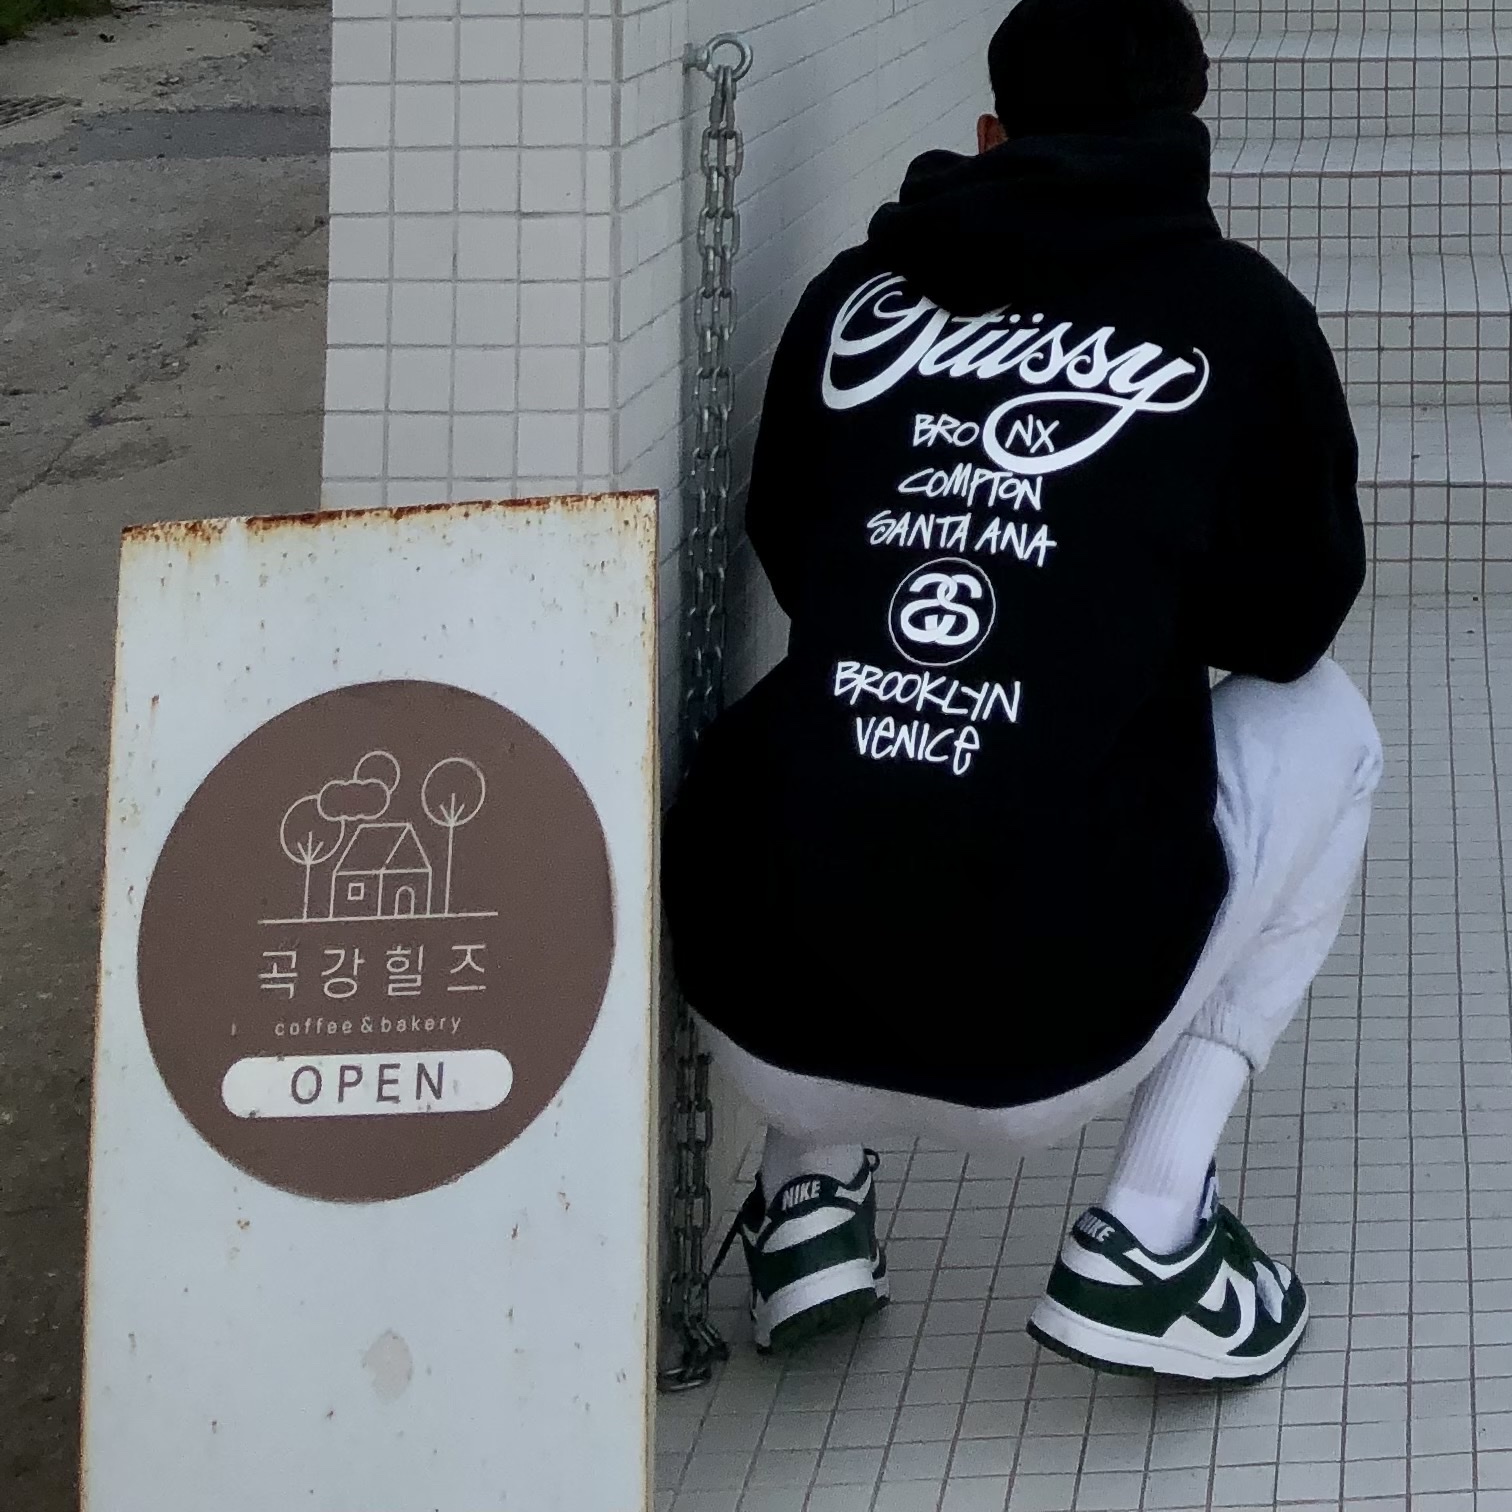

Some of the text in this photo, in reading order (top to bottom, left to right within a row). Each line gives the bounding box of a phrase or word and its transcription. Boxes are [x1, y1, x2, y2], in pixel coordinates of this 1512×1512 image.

[897, 462, 1043, 511] COMPTON
[866, 509, 1058, 568] SANTA ANA
[833, 660, 1021, 724] BROOKLYN
[290, 1061, 445, 1105] OPEN
[781, 1179, 821, 1211] NIKE
